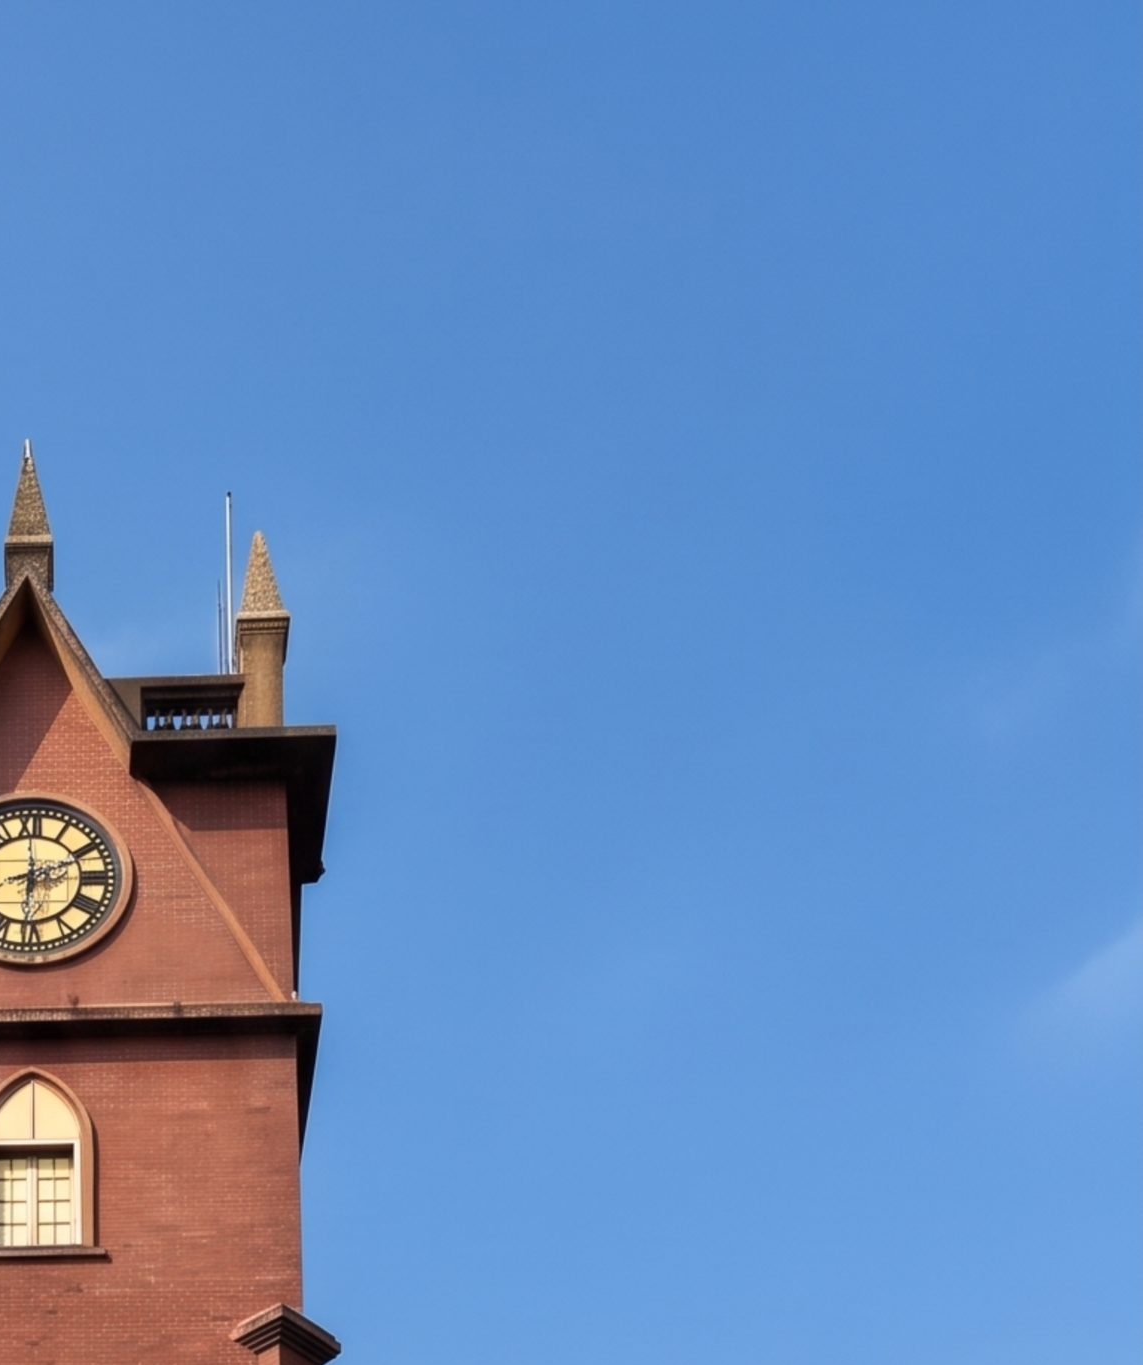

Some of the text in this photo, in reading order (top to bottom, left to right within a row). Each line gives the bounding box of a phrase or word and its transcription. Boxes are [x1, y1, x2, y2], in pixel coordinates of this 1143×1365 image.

[18, 816, 43, 837] XII
[55, 822, 71, 842] I
[72, 841, 98, 859] II
[81, 870, 107, 886] III
